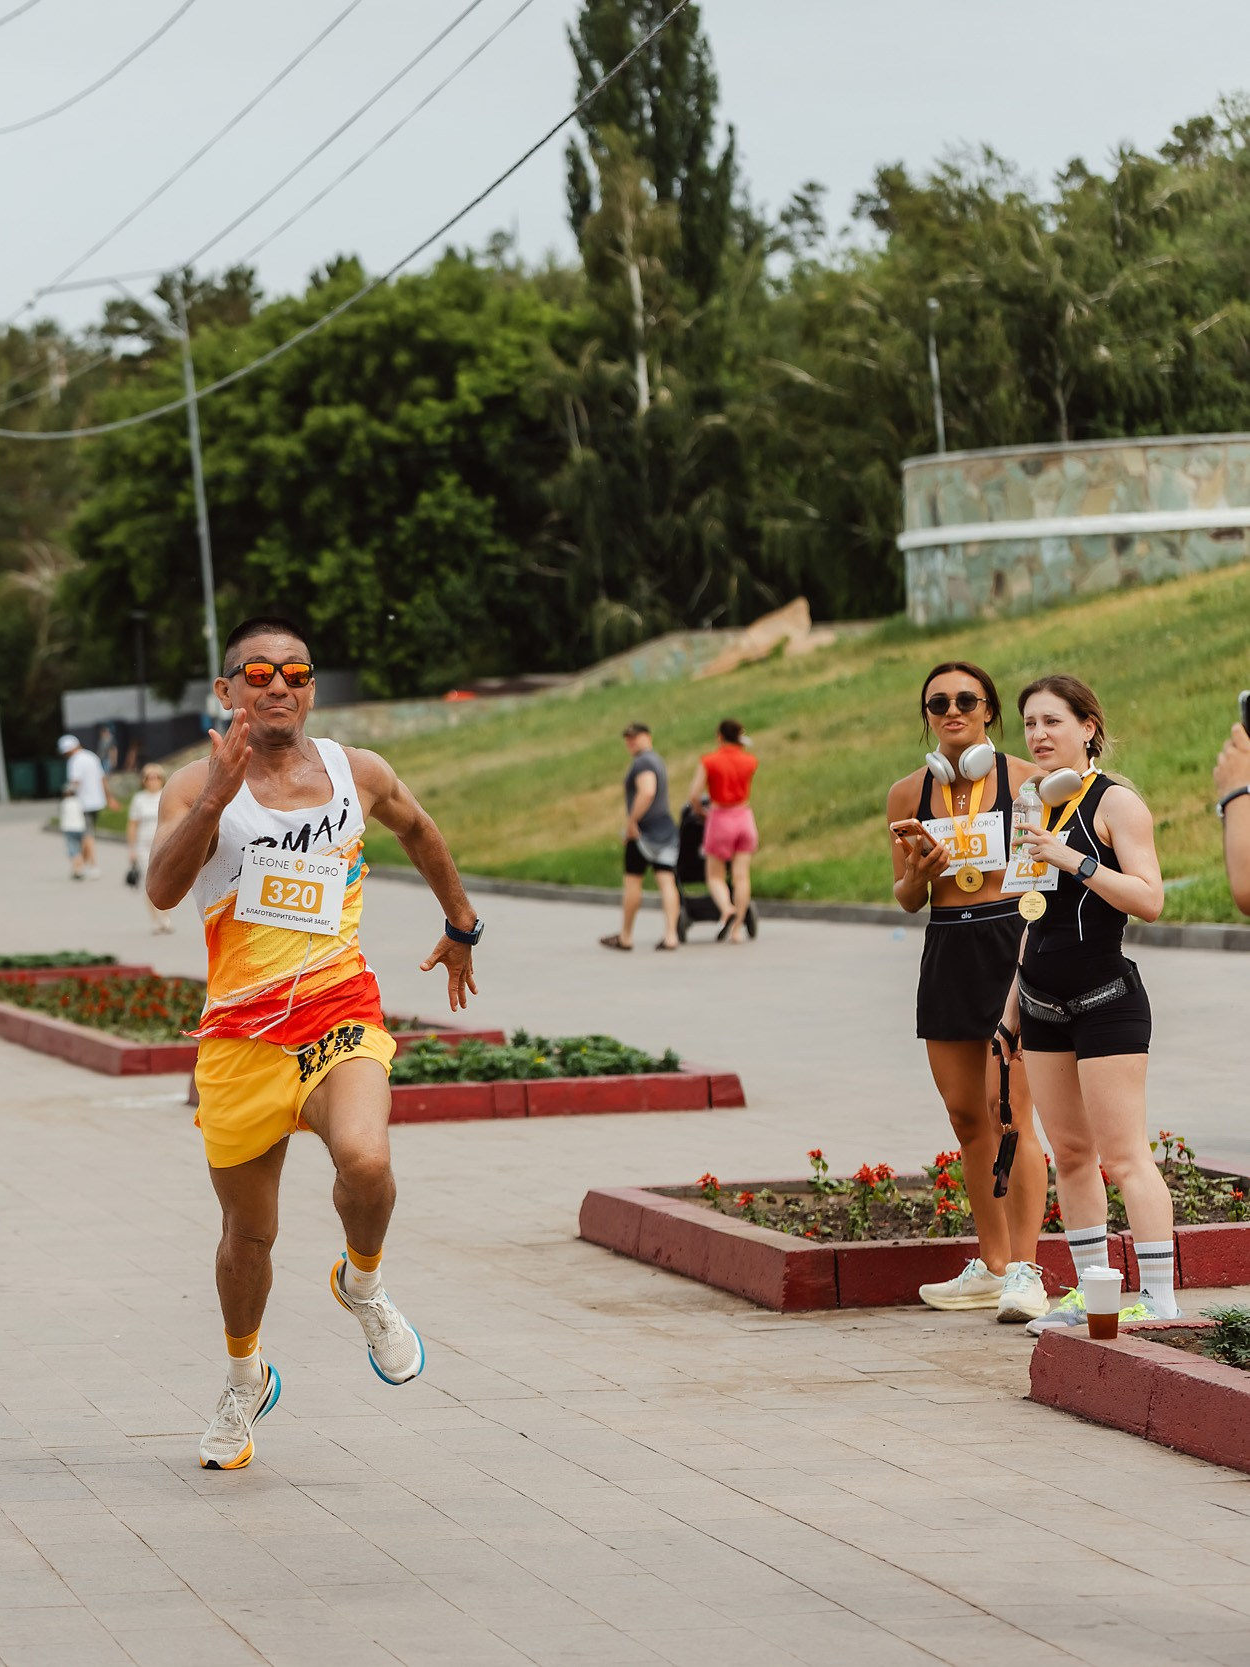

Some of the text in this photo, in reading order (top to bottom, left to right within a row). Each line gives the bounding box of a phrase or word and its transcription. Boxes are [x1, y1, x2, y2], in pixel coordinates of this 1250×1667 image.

[252, 856, 338, 876] LEONE D'ORO
[268, 880, 317, 909] 320
[246, 908, 330, 926] БЛАГОТВОРИТЕЛЬНЫЙ ЗАБЕГ
[960, 910, 972, 920] alo
